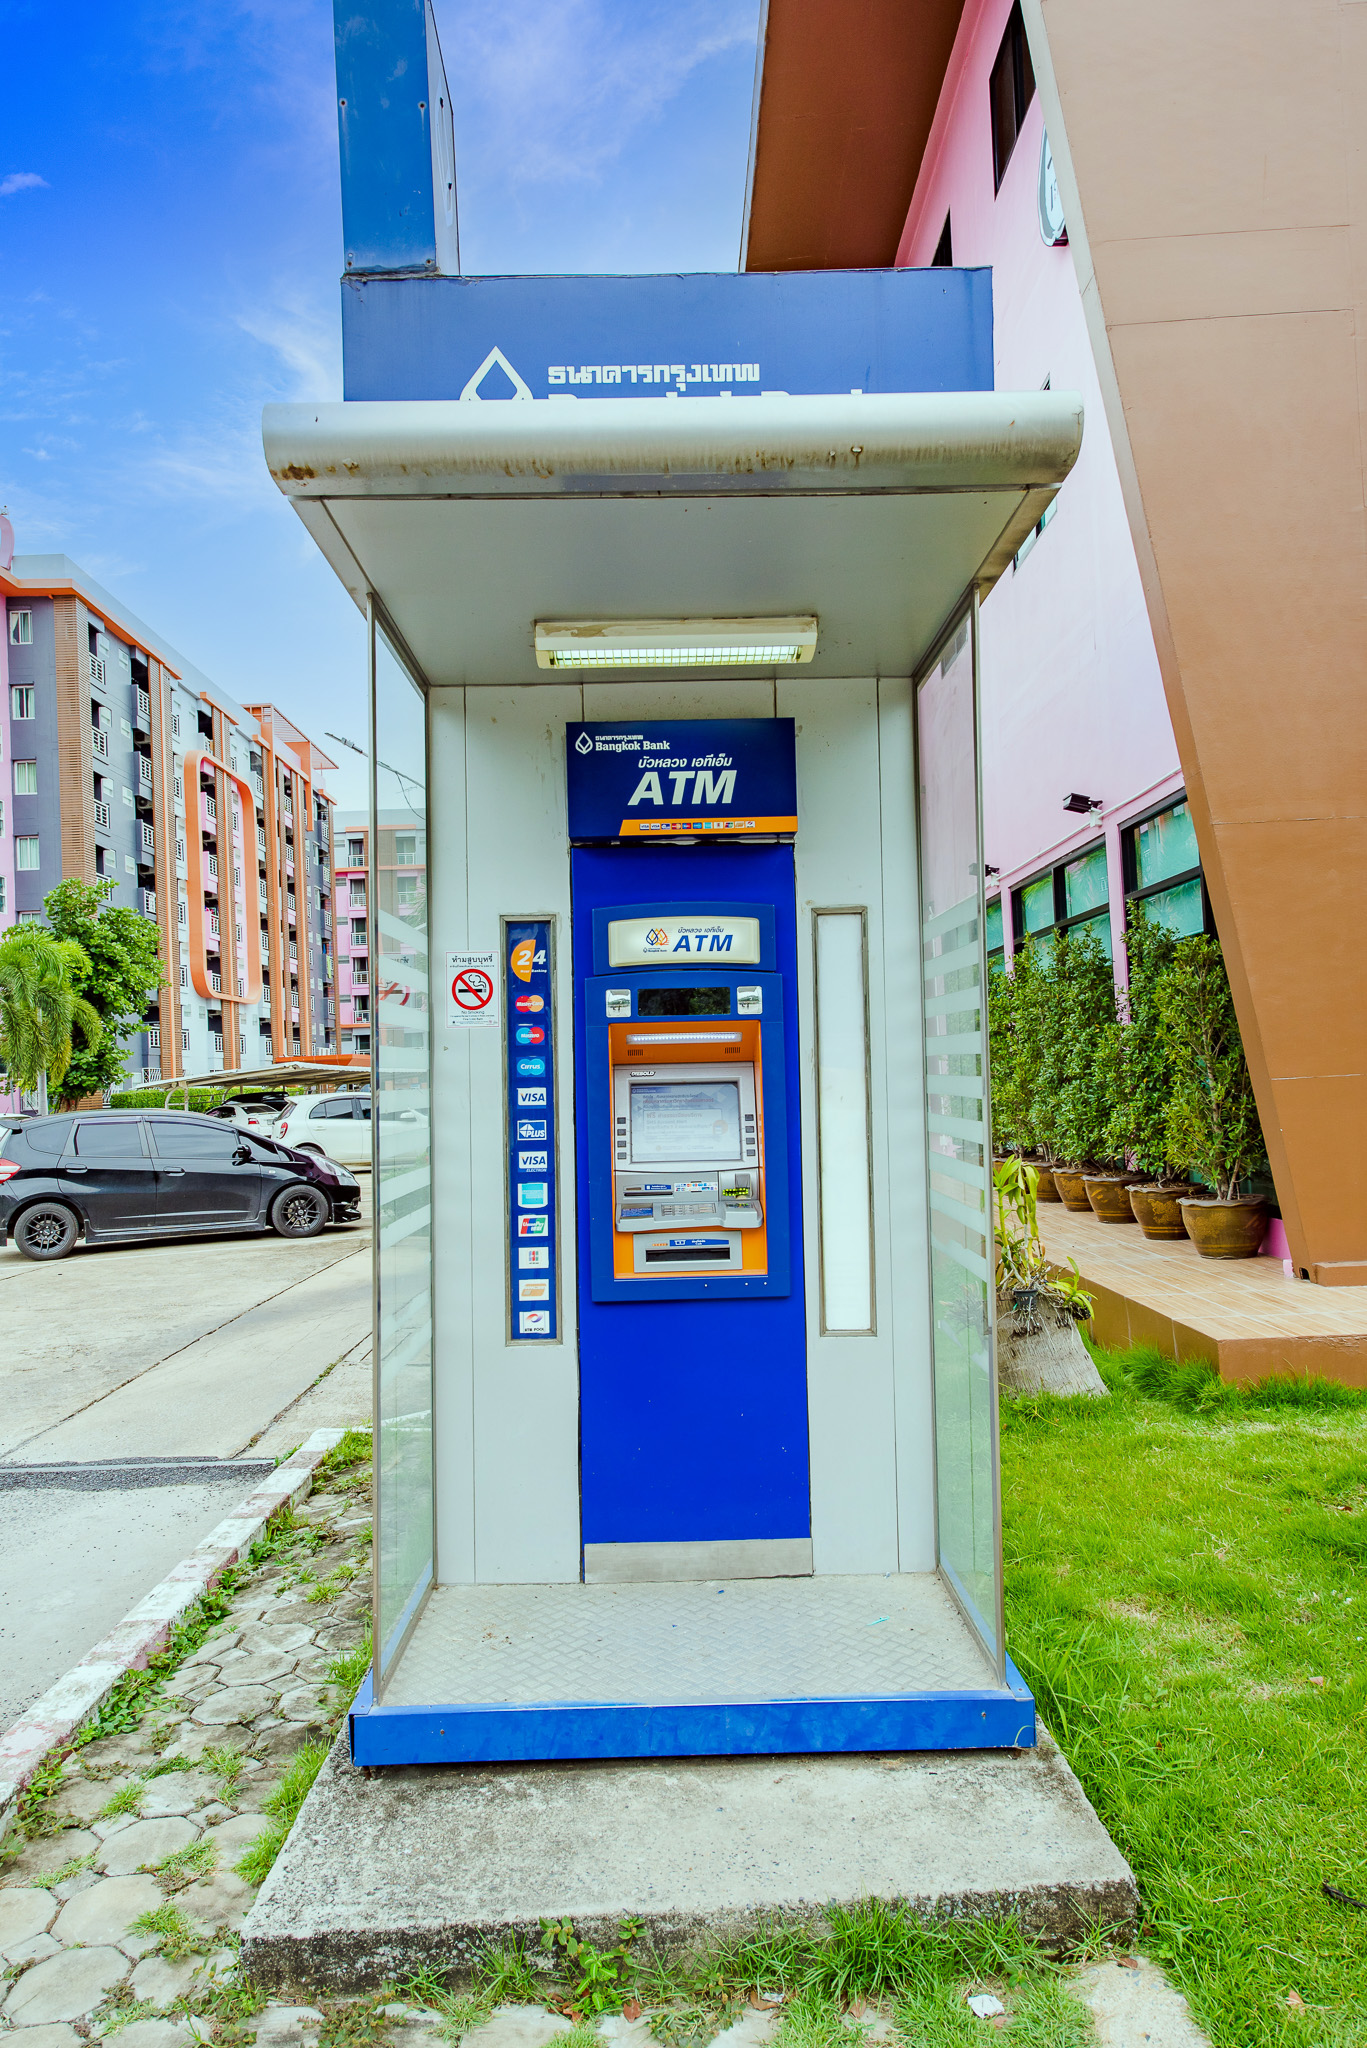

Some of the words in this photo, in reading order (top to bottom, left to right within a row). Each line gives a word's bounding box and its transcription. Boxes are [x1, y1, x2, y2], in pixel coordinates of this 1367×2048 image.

[548, 363, 760, 392] ธนาคารกรุงเทพ
[595, 741, 641, 753] Bangkok
[643, 740, 670, 750] Bank
[638, 755, 687, 768] บัวหลวง
[691, 753, 733, 767] เอทีเอ็ม
[627, 770, 738, 806] ATM
[672, 934, 734, 952] ATM
[452, 954, 493, 964] ห้ามสูบบุหรี่
[516, 949, 547, 966] 24
[520, 1093, 545, 1102] VISA
[525, 1130, 545, 1138] PLUS
[522, 1156, 546, 1165] VISA
